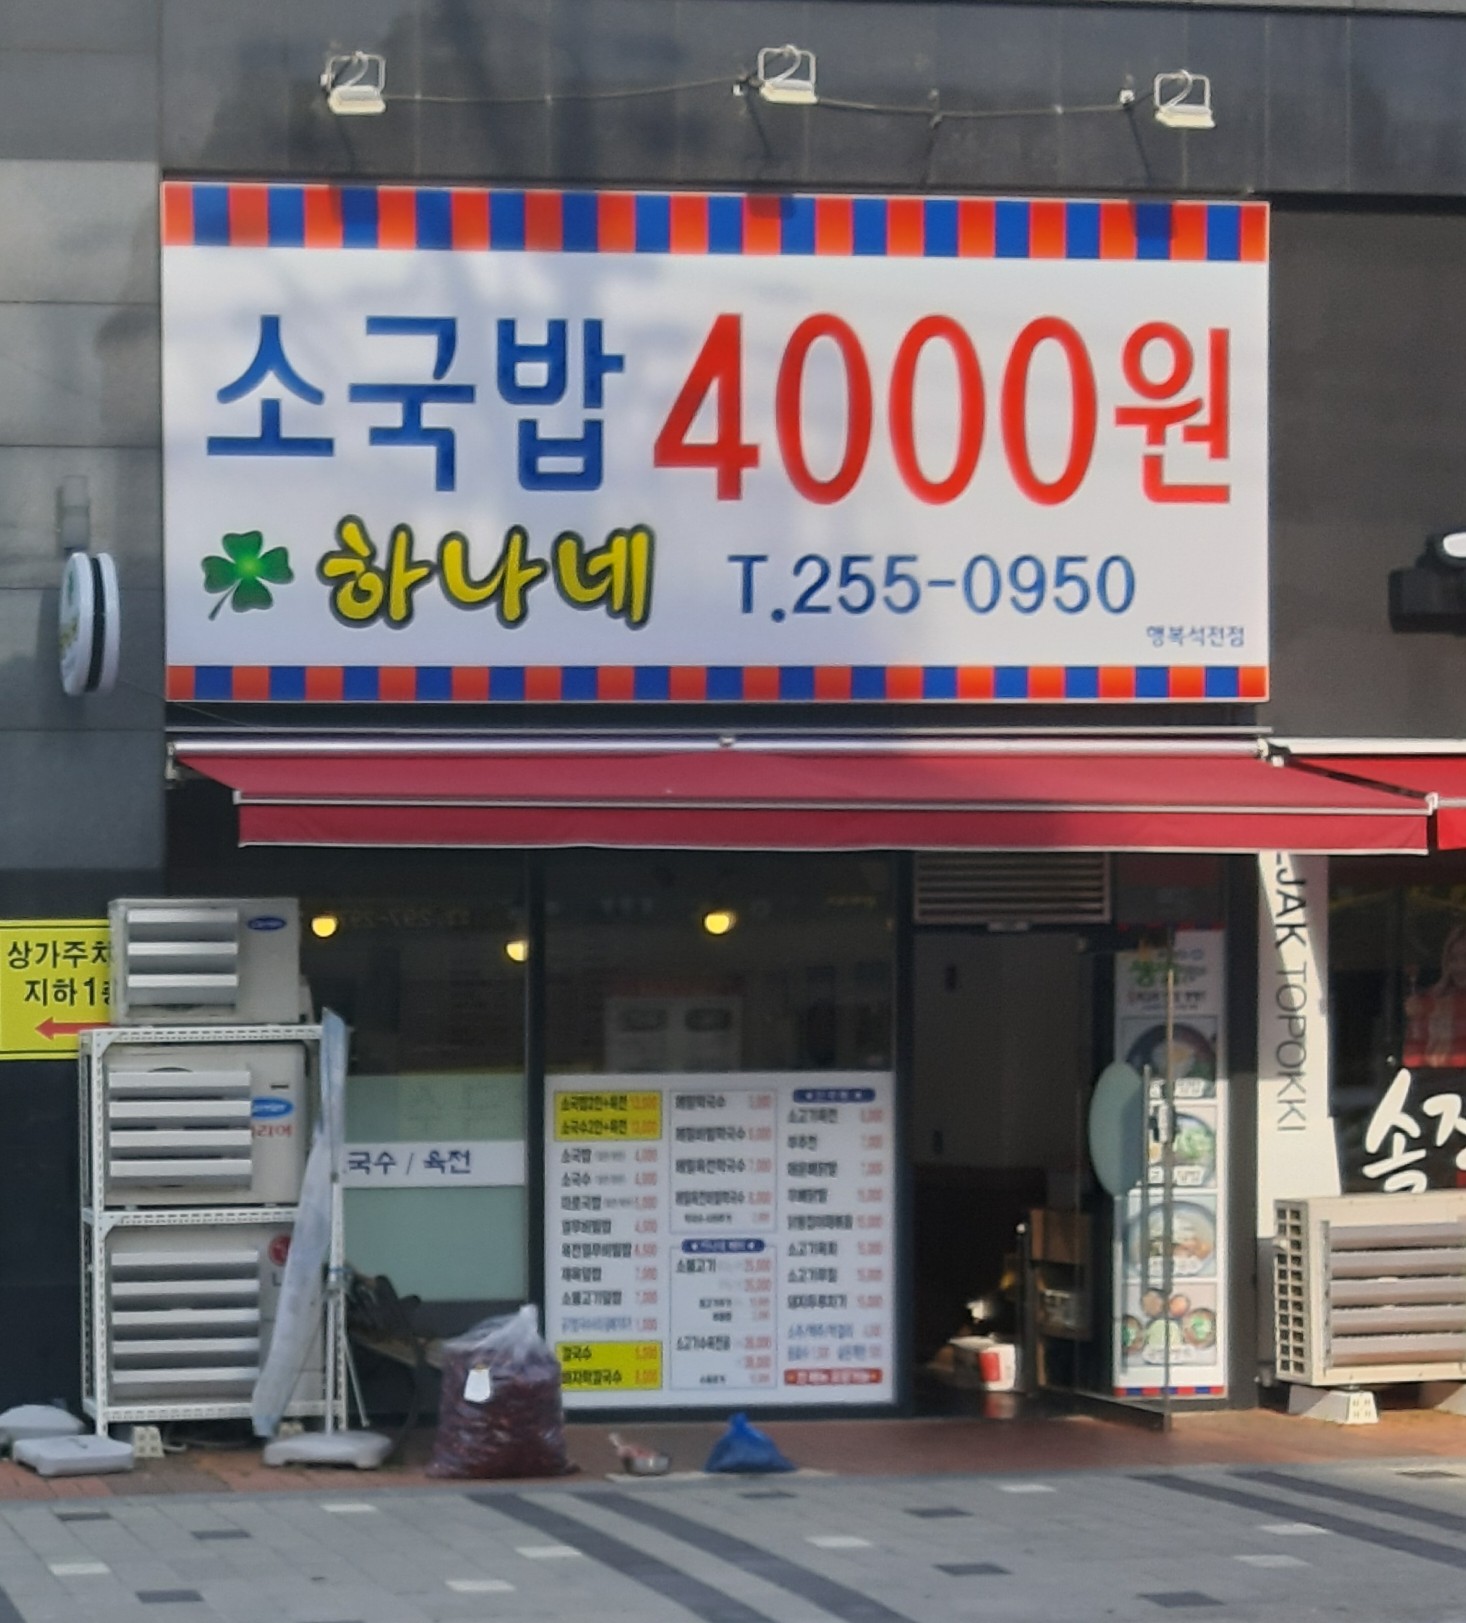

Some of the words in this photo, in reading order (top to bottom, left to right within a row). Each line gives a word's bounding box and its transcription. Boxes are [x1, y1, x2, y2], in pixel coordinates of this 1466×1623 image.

[207, 315, 625, 491] 소국밥
[653, 312, 1230, 506] 4000원
[317, 514, 655, 630] 하나네
[727, 554, 1136, 623] T.255-0950
[1145, 625, 1245, 648] 행복석전점
[1275, 853, 1307, 948] JAK
[1275, 961, 1308, 1131] TOPOKKI
